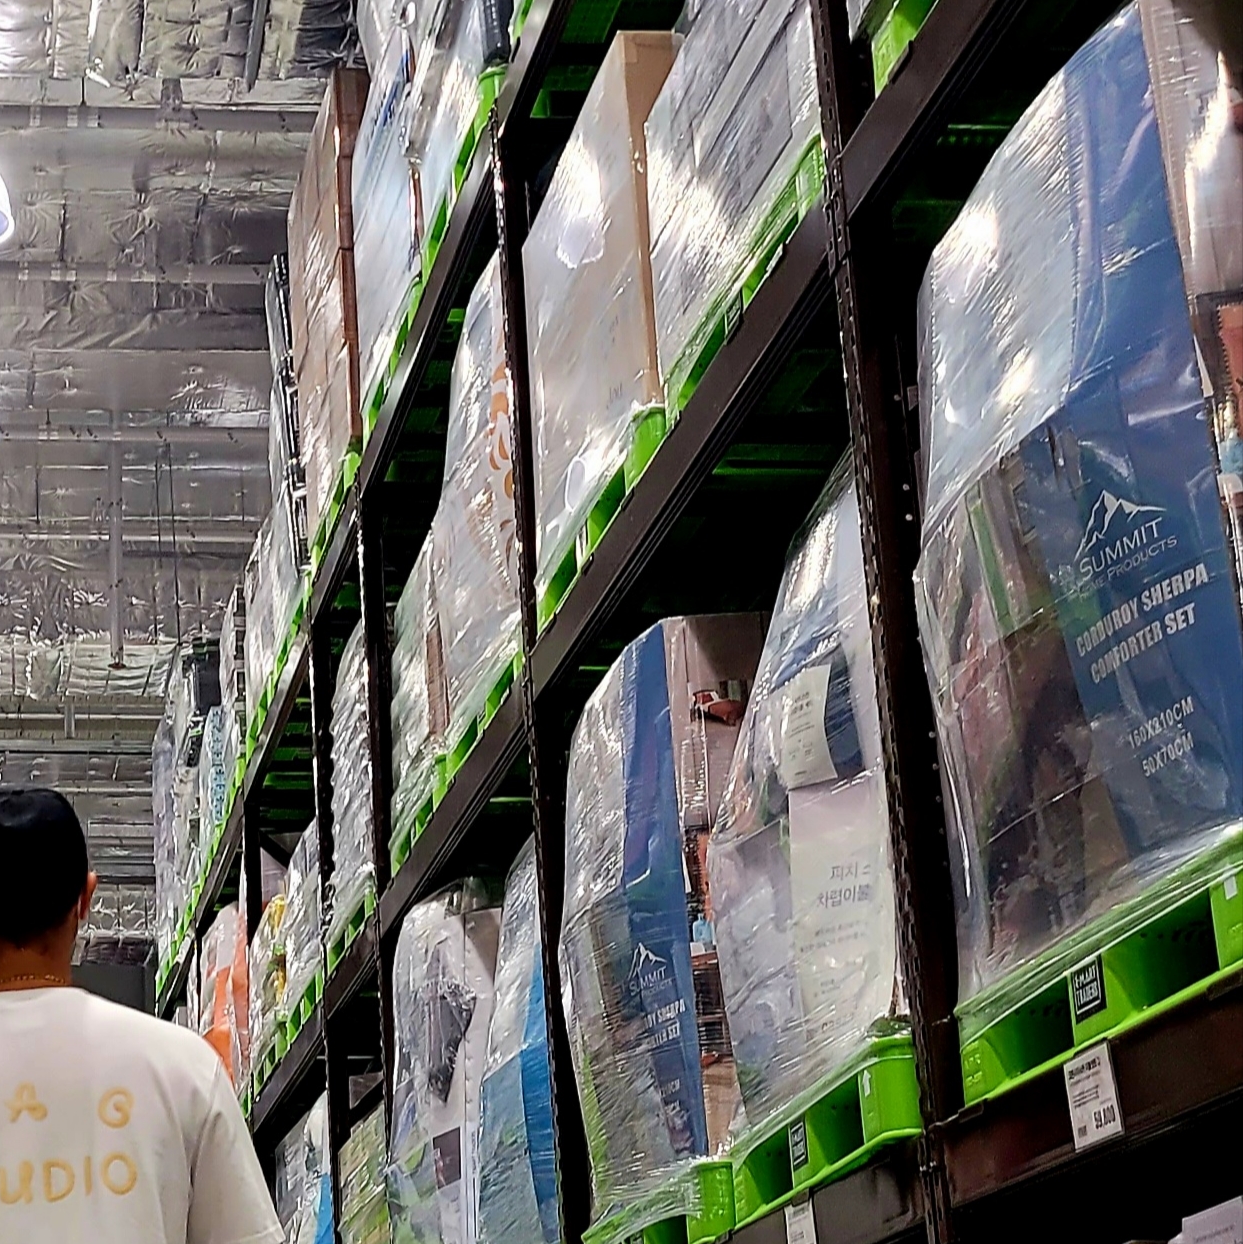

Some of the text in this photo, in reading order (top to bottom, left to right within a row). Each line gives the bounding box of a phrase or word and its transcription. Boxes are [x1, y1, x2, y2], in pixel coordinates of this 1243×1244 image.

[1079, 517, 1162, 581] SUMMIT
[1107, 536, 1177, 580] PRODUCTS
[1076, 563, 1209, 657] CORDUROY SHERPA
[1090, 602, 1195, 684] COMFORTER SET
